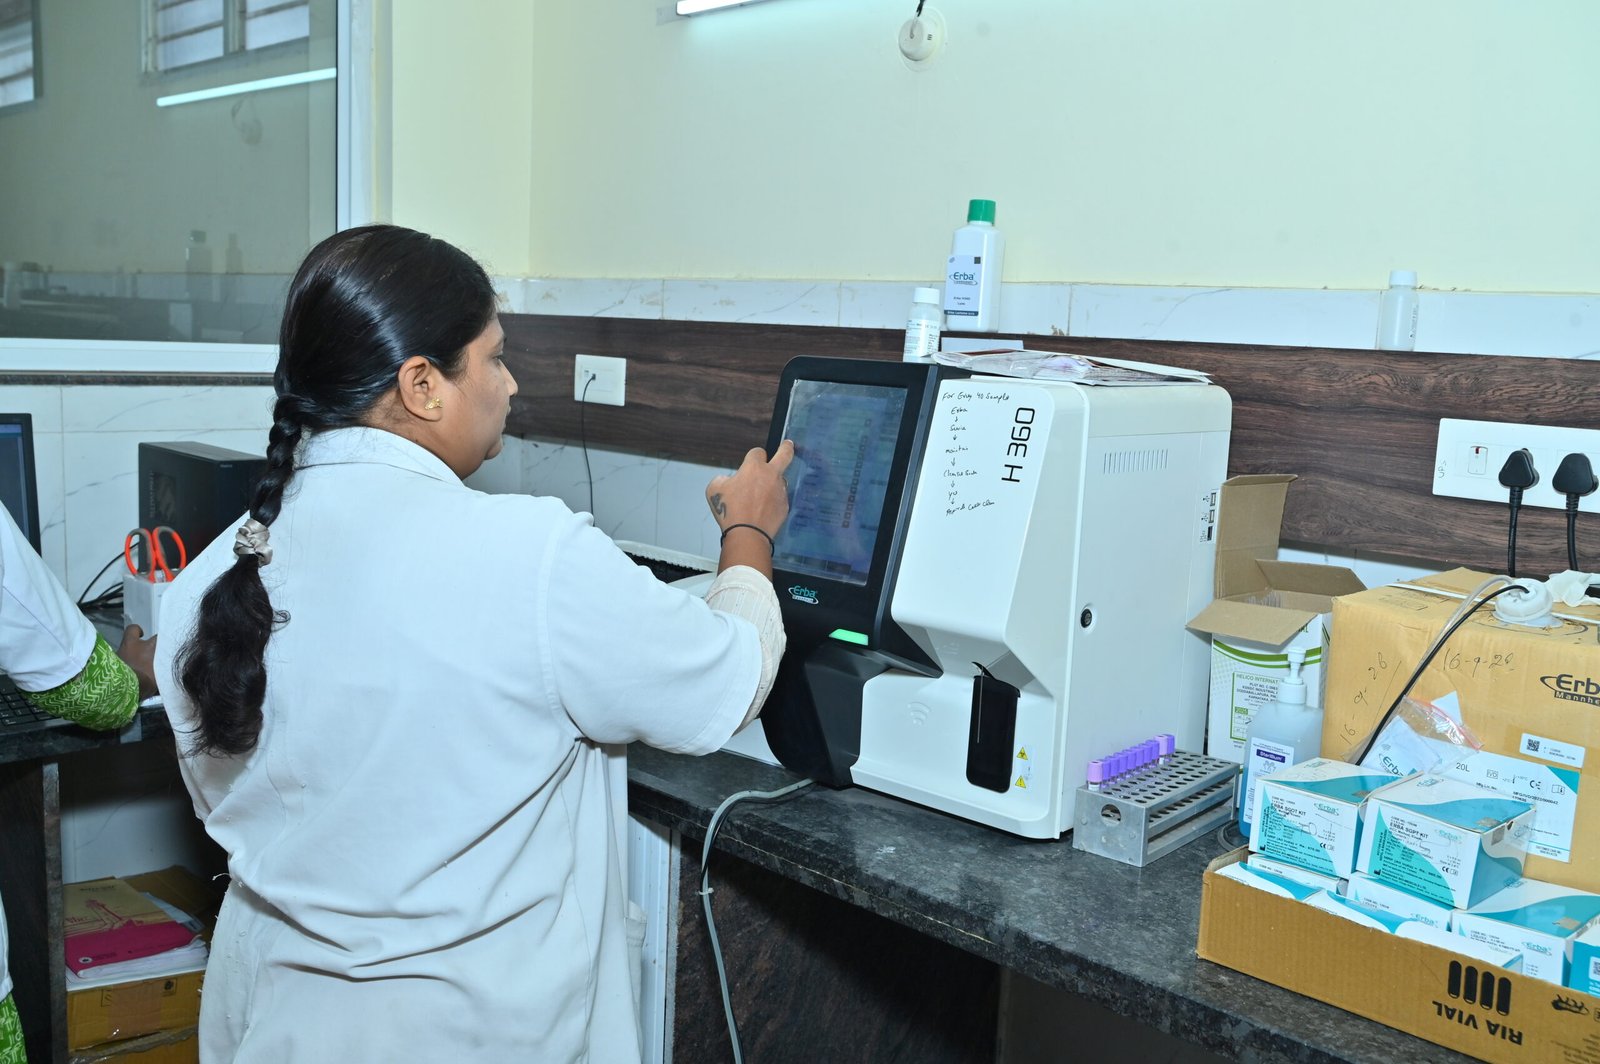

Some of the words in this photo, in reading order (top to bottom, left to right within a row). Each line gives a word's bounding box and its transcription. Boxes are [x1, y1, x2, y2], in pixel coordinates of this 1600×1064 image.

[953, 272, 974, 280] Erba
[942, 392, 956, 402] For
[1007, 407, 1035, 458] 360
[1001, 464, 1023, 483] H
[793, 585, 816, 598] Erba
[1256, 676, 1278, 685] INTERNAT
[1556, 673, 1600, 696] Erb
[1455, 762, 1471, 773] 20L
[1432, 1000, 1478, 1030] VIAL
[1486, 1020, 1523, 1046] RIA
